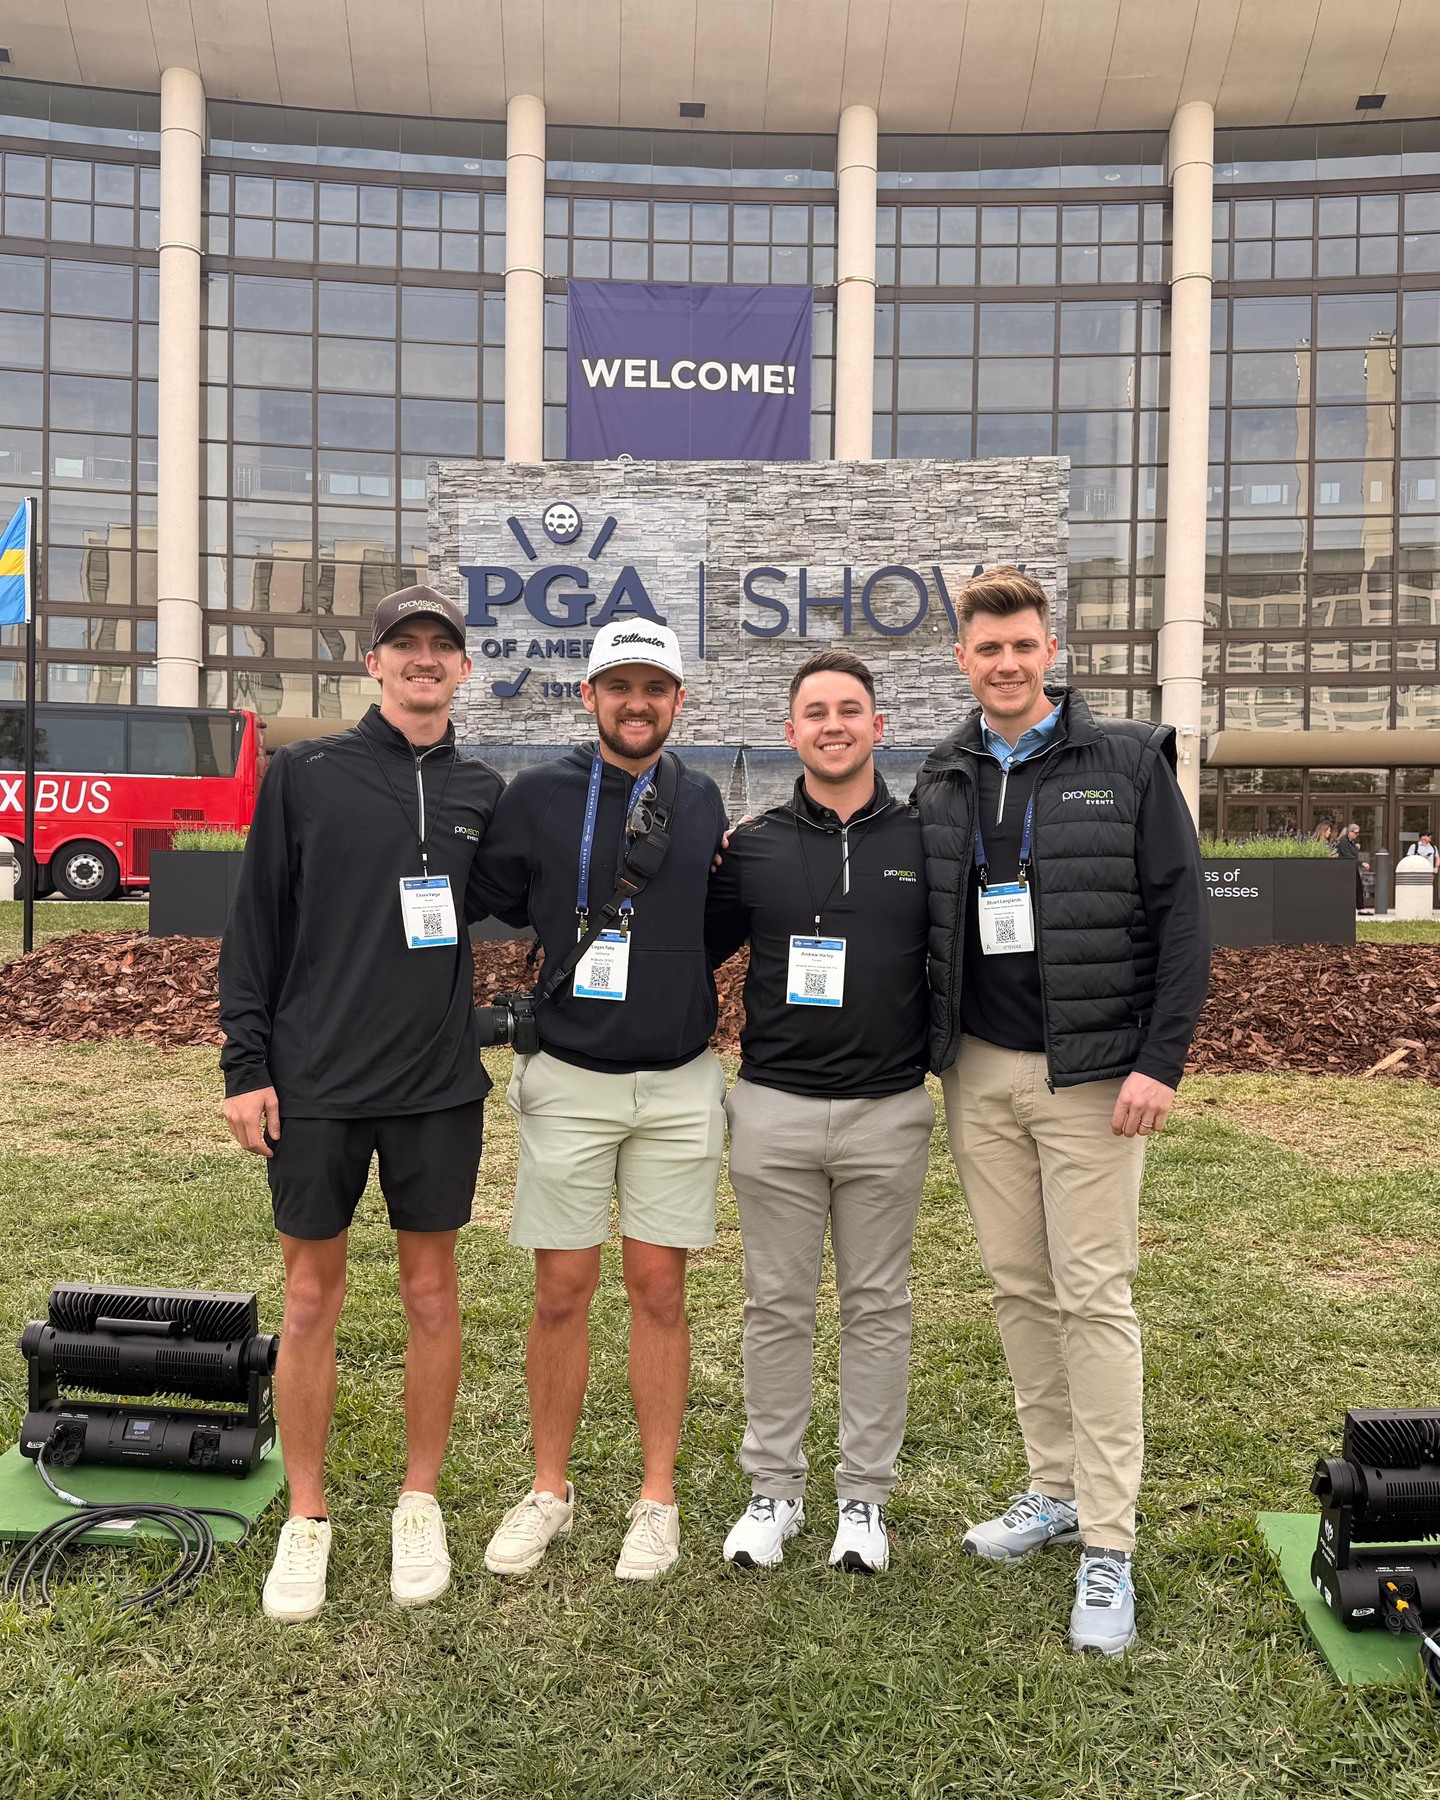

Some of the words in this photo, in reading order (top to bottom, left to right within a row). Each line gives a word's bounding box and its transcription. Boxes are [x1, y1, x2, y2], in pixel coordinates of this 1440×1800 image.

[581, 358, 796, 395] WELCOME!
[459, 565, 667, 627] PGA
[481, 639, 517, 658] OF
[611, 633, 666, 649] Stillwater
[541, 681, 583, 698] 1916
[34, 779, 112, 814] BUS
[1062, 789, 1114, 802] provision
[1223, 868, 1241, 882] of
